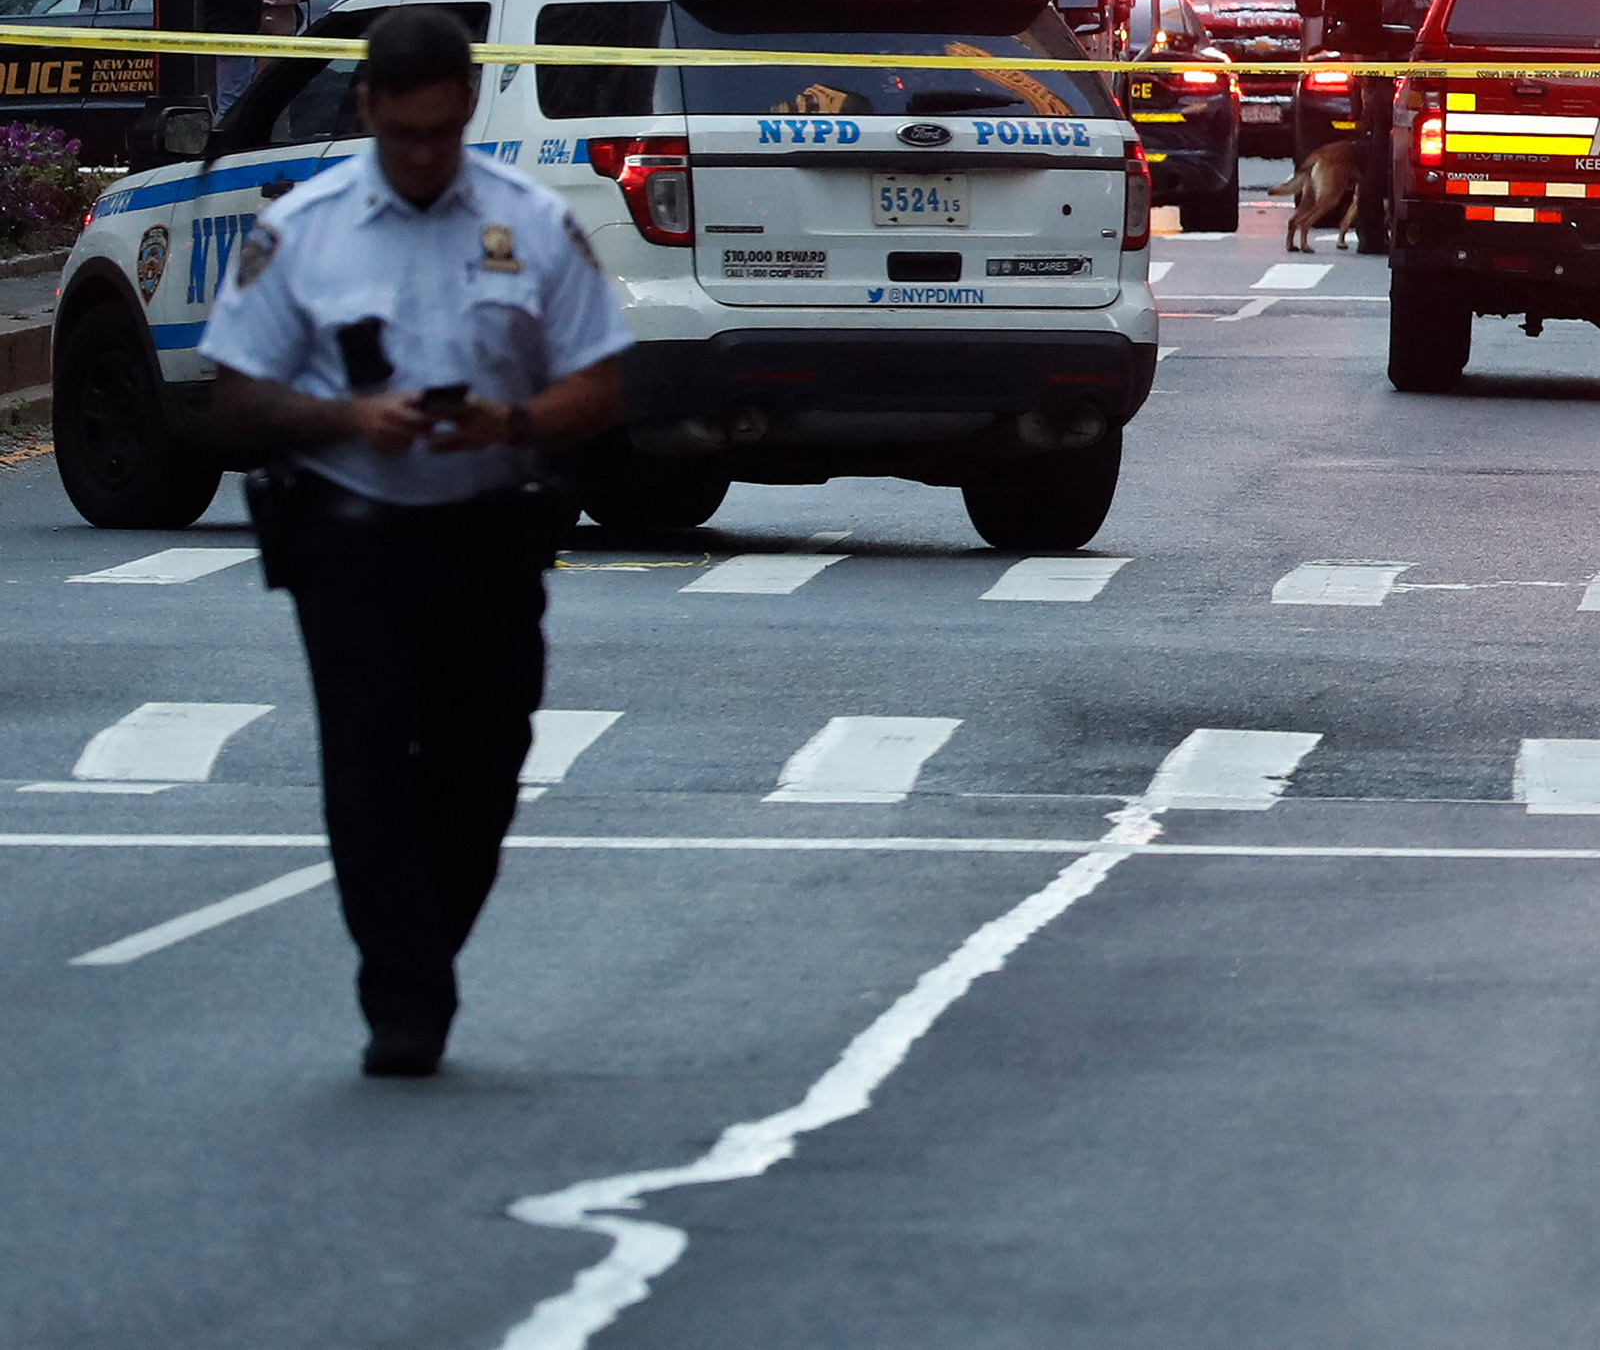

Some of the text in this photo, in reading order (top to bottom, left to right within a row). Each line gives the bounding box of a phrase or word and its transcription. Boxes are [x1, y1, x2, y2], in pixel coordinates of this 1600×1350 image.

[93, 58, 154, 70] NEW YOR
[0, 60, 83, 96] LICE
[92, 70, 154, 82] ENVIRON
[758, 120, 1091, 146] NYPD POLICE
[911, 125, 943, 140] Ford
[1456, 153, 1551, 163] SILVERADO
[881, 187, 961, 213] 5524 15
[724, 250, 827, 264] $10,000 REWARD
[725, 269, 744, 278] CALL
[1018, 261, 1068, 272] PAL CARES
[888, 288, 984, 304] @NYPDMTN
